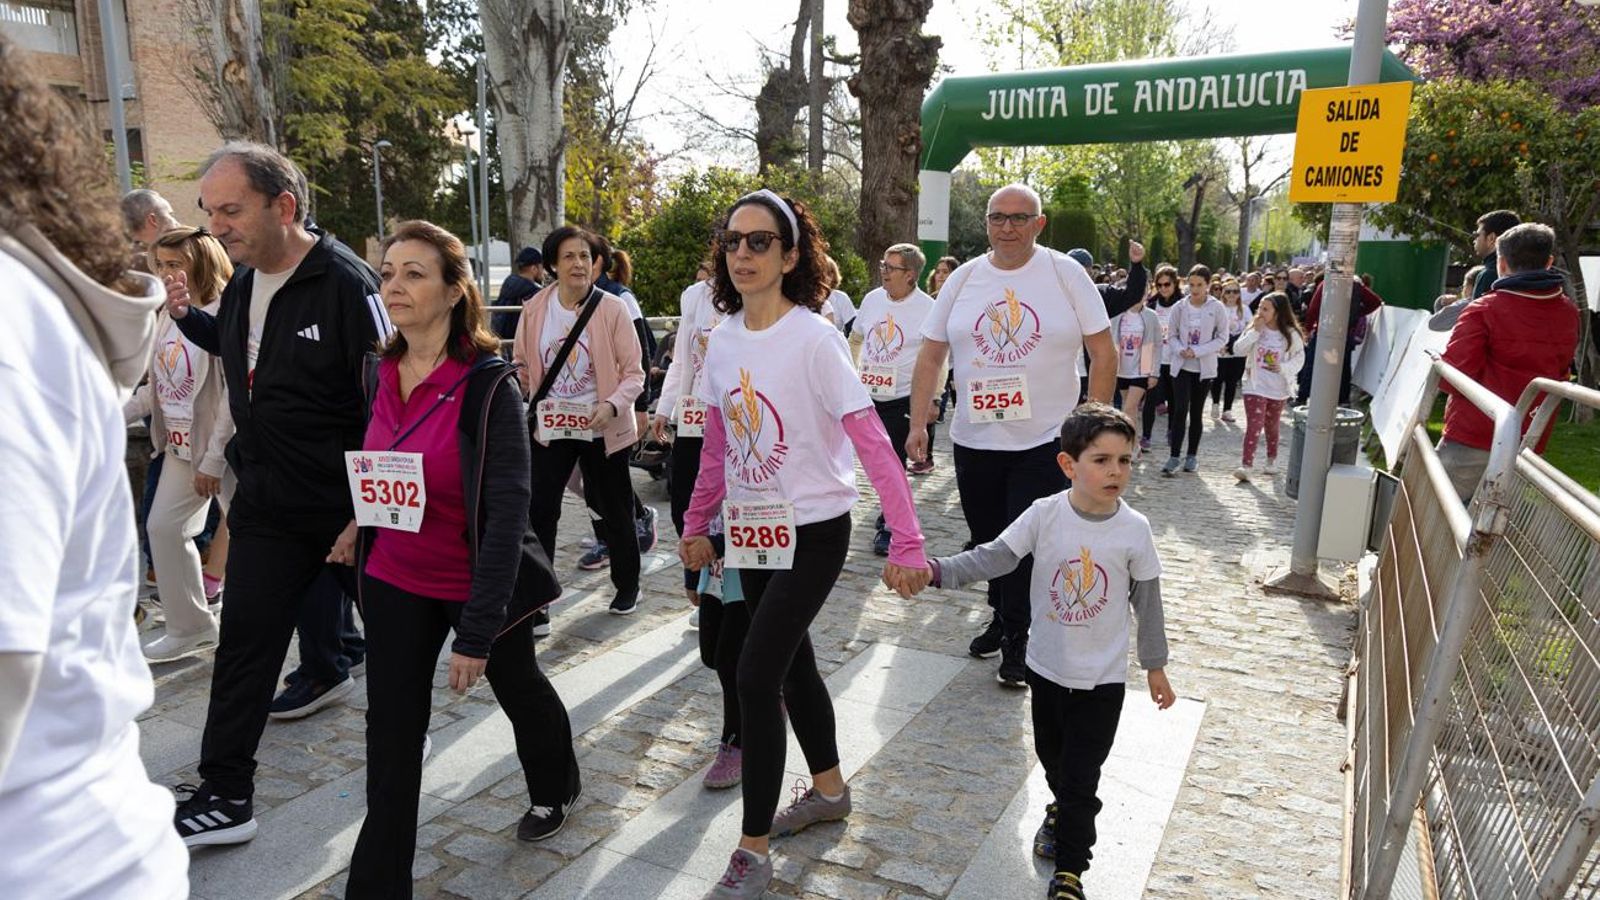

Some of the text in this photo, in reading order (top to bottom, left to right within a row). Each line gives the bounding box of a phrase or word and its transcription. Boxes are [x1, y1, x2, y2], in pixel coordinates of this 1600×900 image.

[981, 86, 1068, 120] JUNTA
[1084, 82, 1119, 116] DE
[1326, 98, 1380, 122] SALIDA
[1340, 132, 1360, 152] DE
[1305, 165, 1384, 187] CAMIONES
[861, 373, 893, 387] 5294
[973, 391, 1024, 410] 5254
[543, 413, 589, 430] 5259
[360, 479, 420, 508] 5302
[730, 525, 790, 548] 5286
